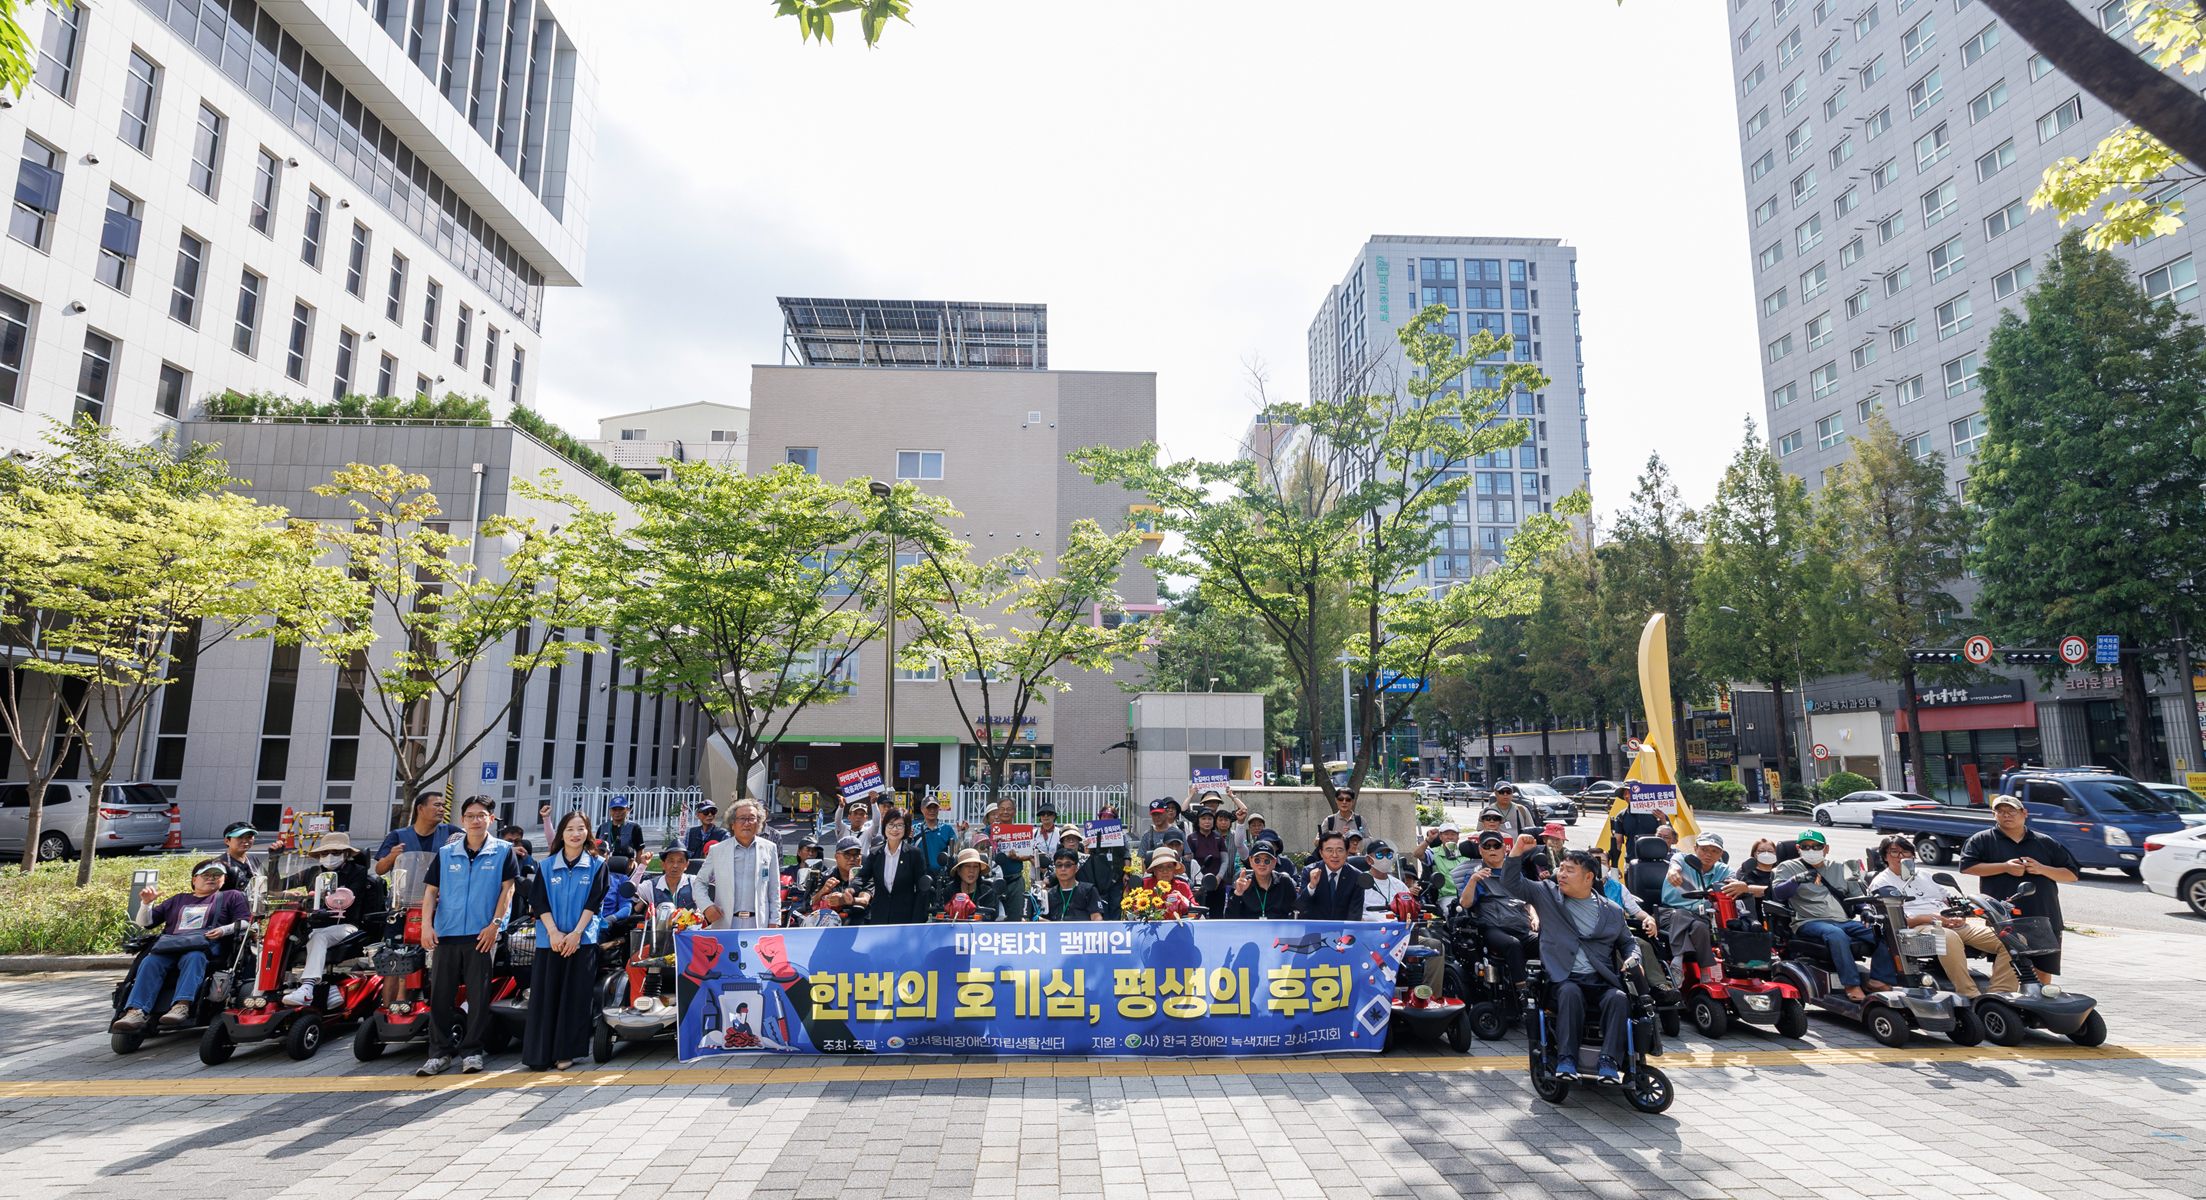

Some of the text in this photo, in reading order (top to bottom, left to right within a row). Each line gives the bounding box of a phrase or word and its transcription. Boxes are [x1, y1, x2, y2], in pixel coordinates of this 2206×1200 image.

[2066, 644, 2082, 656] 50
[1922, 688, 1968, 705] 마녀김밥
[1816, 748, 1825, 756] 50
[485, 768, 491, 778] P
[1632, 790, 1675, 801] 마약퇴치 운동에
[1632, 799, 1675, 809] 너와내가 한마음
[955, 931, 1131, 956] 마약퇴치 캠페인
[808, 964, 1352, 1025] 한번의 호기심, 평생의 후회
[907, 1036, 1065, 1050] 강서웅비장애인자립생활센터
[1091, 1036, 1116, 1049] 지원
[1163, 1034, 1187, 1047] 한국
[1190, 1034, 1227, 1048] 장애인
[1231, 1035, 1281, 1047] 녹색재단
[1284, 1027, 1341, 1046] 강서구지회
